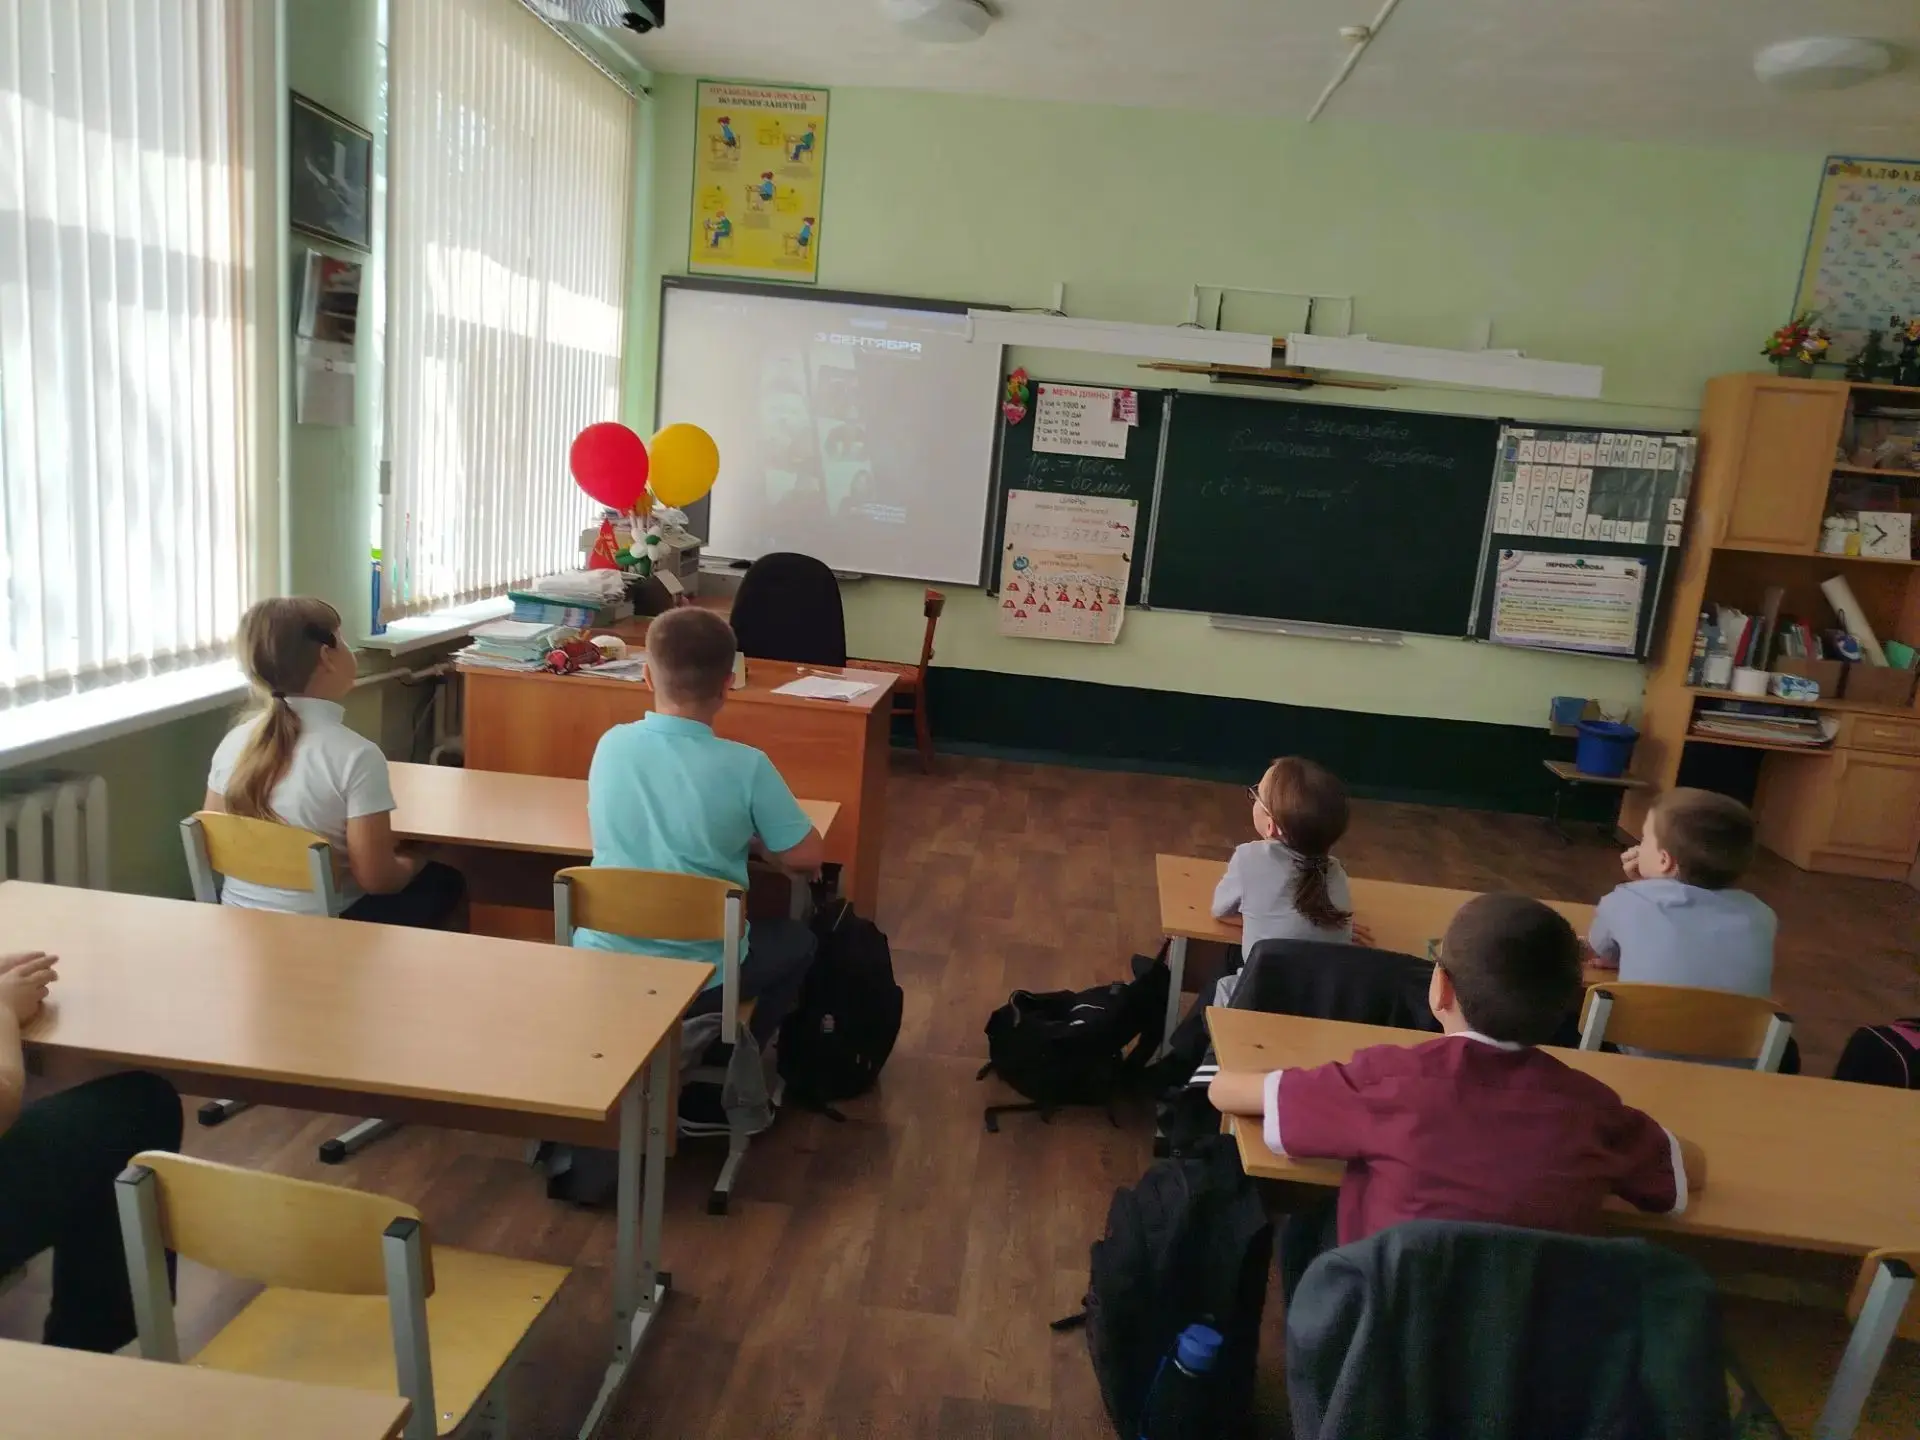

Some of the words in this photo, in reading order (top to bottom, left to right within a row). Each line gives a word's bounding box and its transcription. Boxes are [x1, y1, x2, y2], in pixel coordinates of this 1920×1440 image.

[829, 333, 922, 353] СЕНТЯБРЯ
[1052, 388, 1078, 397] МЕРЫ
[1079, 391, 1111, 399] ДЛИНЫ
[1521, 446, 1531, 457] А
[1537, 445, 1547, 458] О
[1553, 446, 1563, 458] У
[1600, 449, 1610, 463] Н
[1614, 450, 1625, 463] М
[1630, 450, 1642, 464] Л
[1646, 451, 1657, 464] Р
[1548, 471, 1560, 483] Ю
[1564, 472, 1574, 485] Е
[1531, 494, 1539, 507] Г
[1560, 495, 1571, 509] Ж
[1576, 497, 1586, 510] З
[1497, 516, 1508, 529] П
[1526, 519, 1537, 532] К
[1542, 519, 1553, 532] Т
[1572, 522, 1581, 535] С
[1588, 523, 1598, 537] Х
[1602, 525, 1611, 539] Ц
[1618, 526, 1628, 536] Ч
[1666, 528, 1676, 542] Ь
